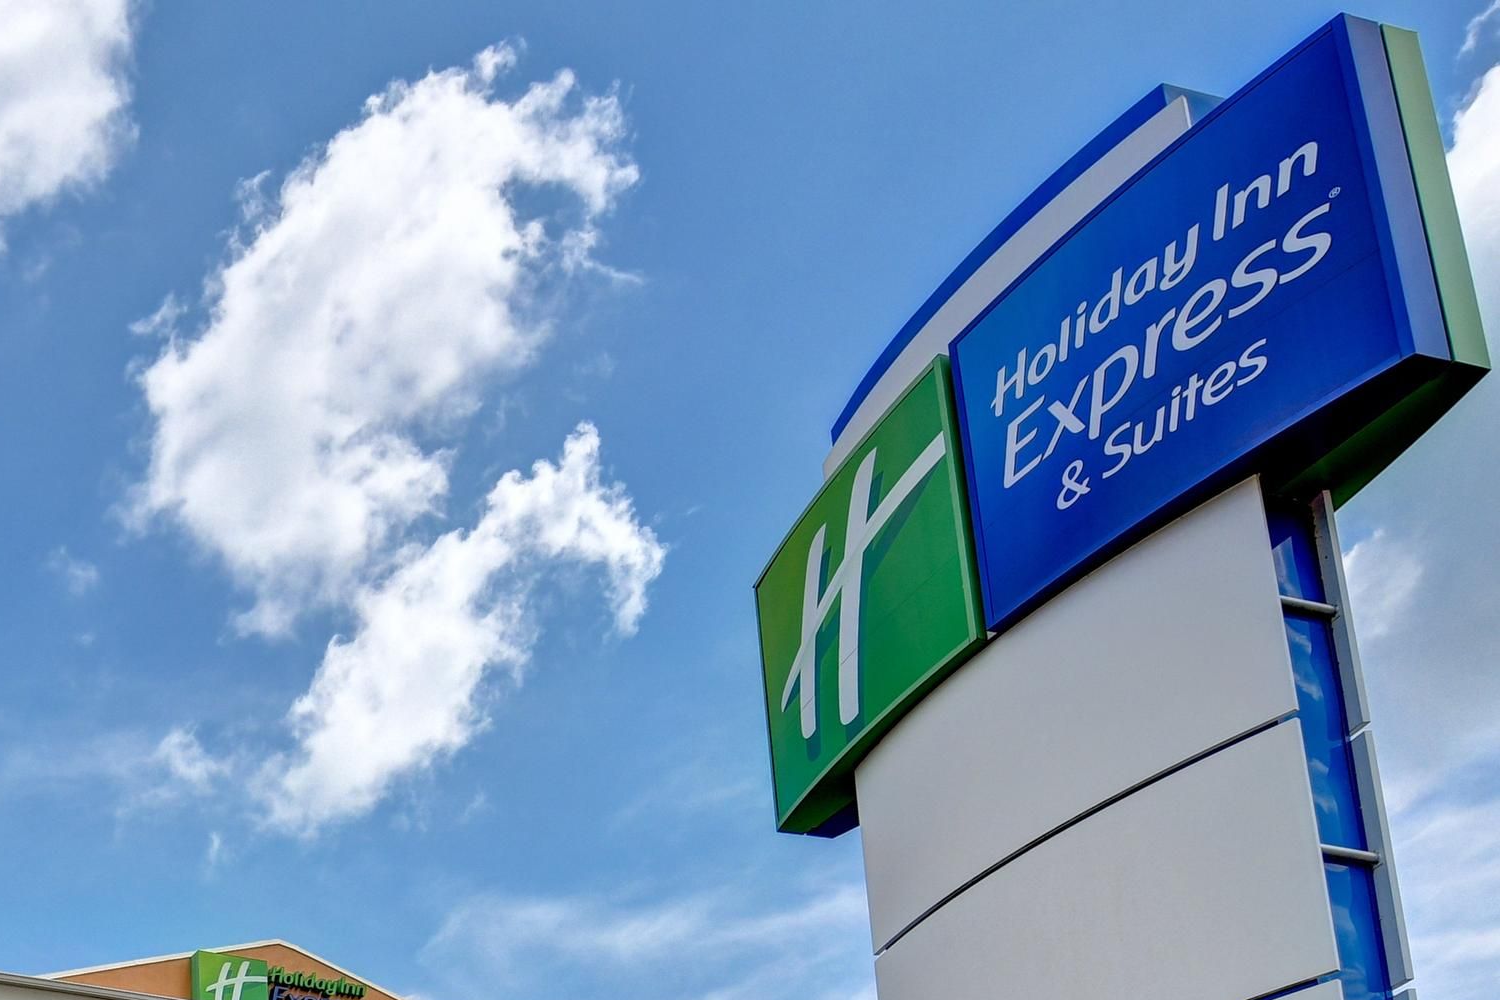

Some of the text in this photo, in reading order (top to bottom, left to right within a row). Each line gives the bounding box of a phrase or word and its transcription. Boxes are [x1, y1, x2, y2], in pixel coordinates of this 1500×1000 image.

[991, 141, 1319, 418] Holiday Inn
[1057, 338, 1268, 511] & Suites
[268, 967, 367, 997] Holiday Inn
